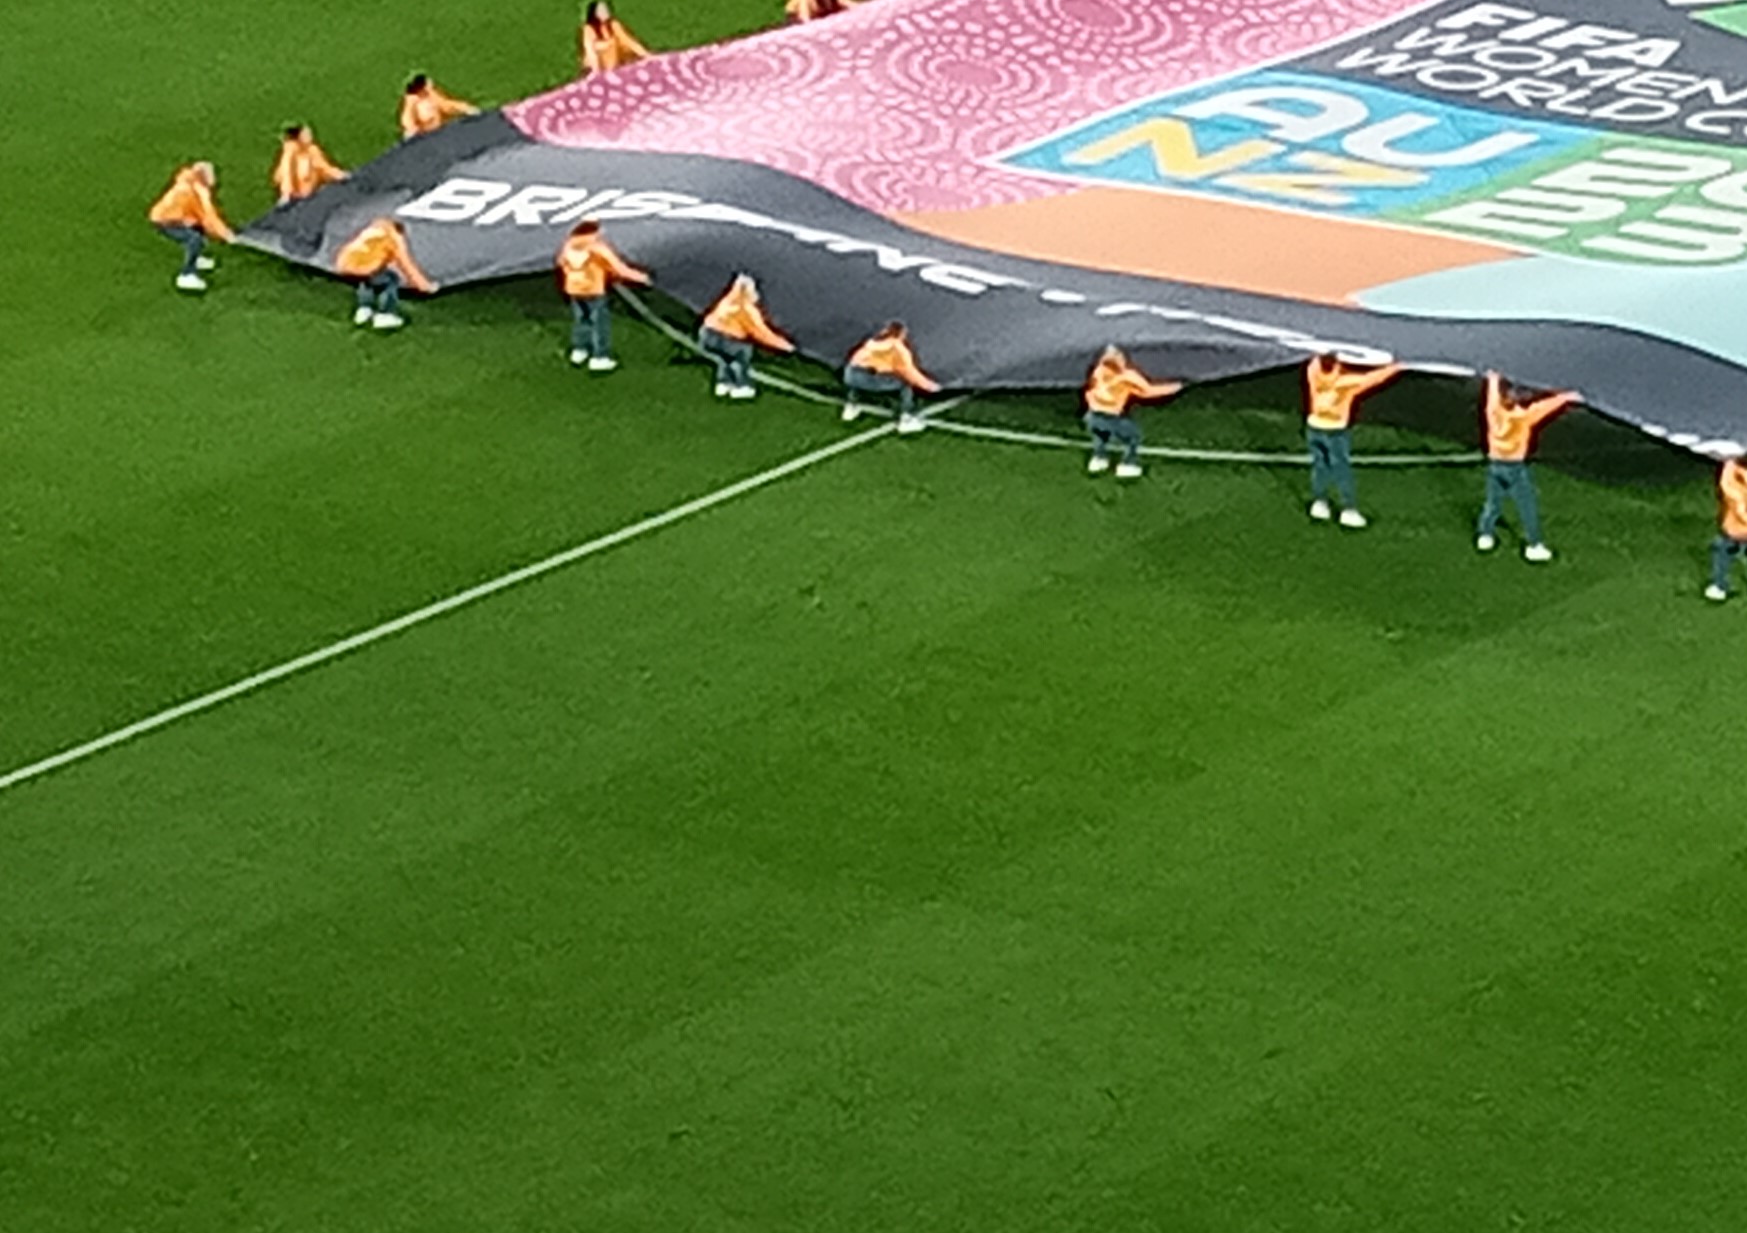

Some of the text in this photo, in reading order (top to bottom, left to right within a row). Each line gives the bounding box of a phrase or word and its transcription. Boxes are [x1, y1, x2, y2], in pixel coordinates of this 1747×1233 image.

[1436, 2, 1681, 68] FIFA
[1335, 46, 1681, 123] WORLD
[1062, 116, 1430, 204] NZ
[1173, 86, 1542, 167] AU
